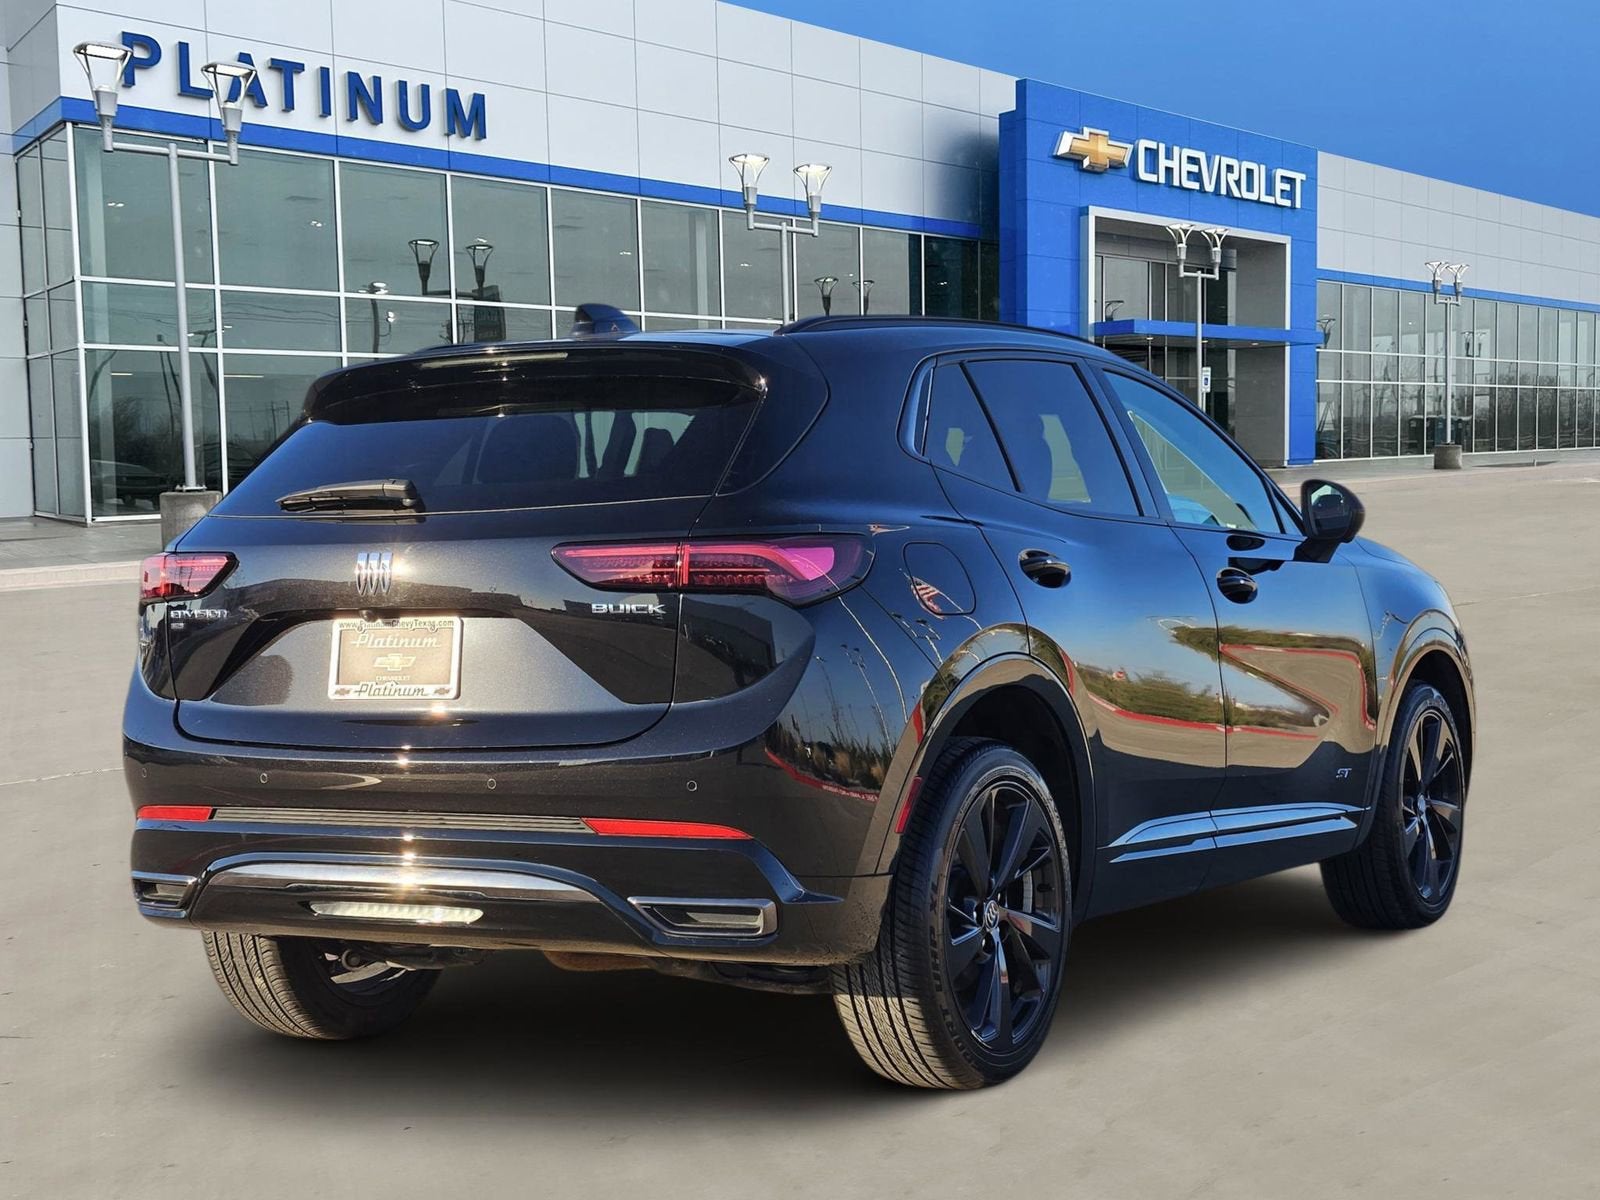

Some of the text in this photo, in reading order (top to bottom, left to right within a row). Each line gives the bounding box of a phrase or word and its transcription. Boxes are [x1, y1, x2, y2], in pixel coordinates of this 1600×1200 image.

[121, 31, 487, 141] PLATINUM
[1135, 138, 1307, 209] CHEVROLET
[170, 608, 228, 619] ENVISION
[591, 603, 667, 614] BUICK
[350, 632, 443, 648] Platinum
[354, 682, 430, 697] Platinum
